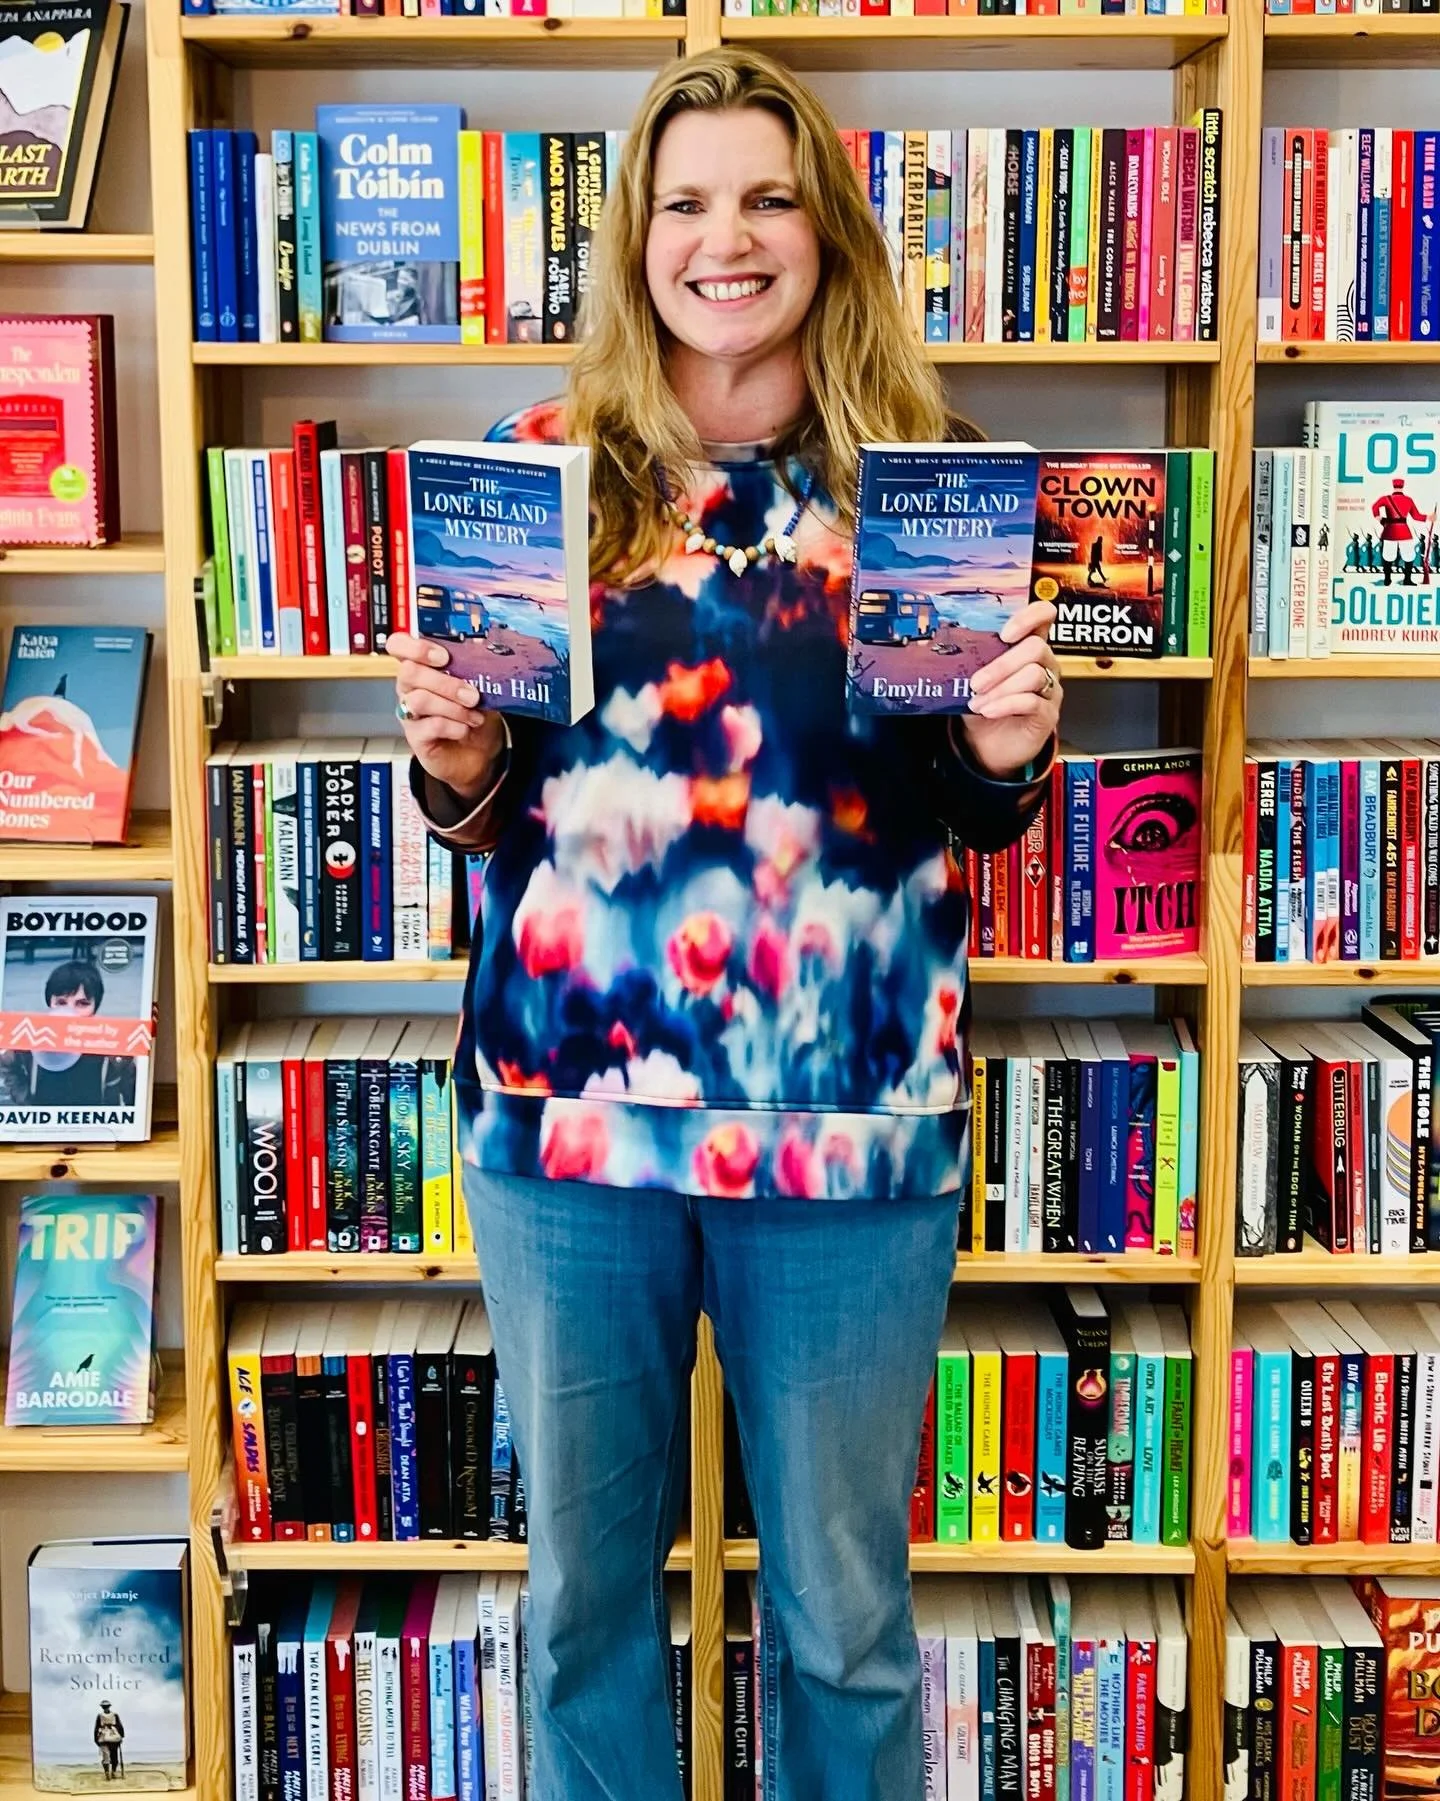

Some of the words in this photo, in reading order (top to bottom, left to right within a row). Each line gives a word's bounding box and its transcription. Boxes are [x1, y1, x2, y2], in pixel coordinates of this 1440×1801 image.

[23, 8, 93, 22] ANAPPARA
[1206, 112, 1219, 144] little
[0, 144, 53, 164] LAST
[339, 133, 433, 166] Colm
[576, 146, 588, 160] IN
[588, 141, 600, 150] A
[1361, 133, 1371, 157] ELEY
[1424, 136, 1436, 171] THINK
[549, 138, 564, 187] AMOR
[1203, 146, 1217, 204] scratch
[333, 167, 444, 200] Tóibín
[576, 164, 589, 228] MOSCOW
[1127, 154, 1139, 218] HOMECOMING
[1360, 158, 1370, 204] WILLIAMS
[1423, 175, 1434, 209] AGAIN
[377, 208, 399, 218] THE
[907, 139, 924, 261] AFTERPARTIES
[336, 221, 386, 237] NEWS
[392, 221, 441, 237] FROM
[550, 188, 565, 252] TOWLES
[356, 240, 420, 256] DUBLIN
[1202, 206, 1215, 267] rebecca
[548, 257, 560, 283] FOR
[576, 241, 589, 294] TOWLES
[1420, 233, 1432, 282] Jacqueline
[548, 285, 560, 315] TWO
[558, 267, 570, 304] TABLE
[1200, 269, 1213, 325] watson
[1421, 285, 1431, 317] Wilson
[932, 296, 943, 321] VIDA
[1337, 432, 1437, 484] LOS
[469, 477, 500, 496] THE
[935, 473, 969, 489] THE
[1039, 475, 1155, 498] CLOWN
[423, 491, 476, 517] LONE
[480, 496, 548, 526] ISLAND
[879, 493, 938, 514] LONE
[943, 493, 1019, 513] ISLAND
[1051, 497, 1146, 519] TOWN
[444, 518, 530, 546] MYSTERY
[900, 518, 997, 539] MYSTERY
[371, 525, 384, 577] POIROT
[1294, 559, 1306, 597] SILVER
[1318, 560, 1329, 595] STOLEN
[1057, 603, 1131, 625] MICK
[1293, 600, 1305, 629] BONE
[1317, 598, 1328, 629] HEART
[20, 633, 59, 652] Katya
[1341, 629, 1396, 643] ANDREY
[18, 646, 56, 660] Balen
[510, 677, 551, 704] Hall
[872, 678, 943, 703] Emylia
[0, 770, 36, 790] Our
[232, 770, 245, 793] IAN
[1123, 763, 1161, 773] GEMMA
[1164, 759, 1191, 770] AMOR
[341, 764, 355, 822] LADY
[1073, 778, 1090, 807] THE
[1260, 770, 1274, 817] VERGE
[1365, 770, 1377, 795] RAY
[0, 789, 96, 810] Numbered
[326, 764, 340, 837] JOKER
[1386, 789, 1398, 840] FAHRENHEIT
[233, 795, 247, 846] RANKIN
[1365, 795, 1377, 864] BRADBURY
[279, 820, 295, 881] KALMANN
[1073, 813, 1089, 872] FUTURE
[1386, 841, 1397, 868] 451
[236, 849, 247, 891] MIDNIGHT
[1259, 849, 1273, 891] NADIA
[1386, 871, 1396, 888] RAY
[236, 893, 247, 914] AND
[1112, 882, 1196, 934] ITCH
[1258, 896, 1272, 937] ATTIA
[1386, 888, 1396, 932] BRADBURY
[6, 911, 148, 932] BOYHOOD
[236, 915, 247, 939] BLUE
[400, 913, 410, 950] TURTON
[411, 913, 421, 950] STUART
[1418, 1055, 1431, 1089] THE
[336, 1081, 349, 1115] FIFTH
[368, 1083, 381, 1137] OBELISK
[396, 1083, 411, 1137] STONE
[1047, 1095, 1063, 1127] THE
[1332, 1074, 1346, 1148] JITTERBUG
[57, 1111, 136, 1126] KEENAN
[1417, 1093, 1430, 1138] HOLE
[336, 1117, 349, 1168] SEASON
[368, 1138, 380, 1170] GATE
[396, 1140, 410, 1169] SKY
[1047, 1128, 1062, 1178] GREAT
[253, 1121, 277, 1206] WOOL
[1047, 1181, 1062, 1228] WHEN
[26, 1212, 145, 1261] TRIP
[48, 1370, 101, 1389] AMIE
[236, 1367, 253, 1393] ACE
[1145, 1362, 1154, 1389] GWEN
[1346, 1363, 1358, 1382] DAY
[15, 1390, 133, 1410] BARRODALE
[1144, 1395, 1154, 1415] ART
[1373, 1371, 1388, 1424] Electric
[1170, 1399, 1186, 1431] FAINT
[1344, 1408, 1357, 1441] WHALE
[242, 1420, 260, 1473] SPADES
[1169, 1439, 1185, 1473] HEART
[1372, 1428, 1387, 1453] Life
[400, 1453, 411, 1481] DEAN
[1071, 1435, 1086, 1496] REAPING
[1093, 1438, 1107, 1495] SUNRISE
[1143, 1446, 1154, 1473] LOVE
[401, 1481, 412, 1503] ATTA
[101, 1589, 139, 1604] Daanje
[482, 1600, 494, 1618] LIZE
[40, 1646, 171, 1666] Remembered
[482, 1625, 495, 1670] MEDDINGS
[996, 1655, 1010, 1671] THE
[70, 1674, 144, 1692] Soldier
[357, 1660, 373, 1683] THE
[1099, 1677, 1110, 1698] THE
[1136, 1672, 1146, 1701] FAKE
[1354, 1651, 1366, 1703] PULLMAN
[1367, 1658, 1377, 1695] PHILIP
[458, 1693, 471, 1723] Wish
[733, 1676, 749, 1724] HIDDEN
[996, 1676, 1018, 1750] CHANGING
[1110, 1672, 1122, 1724] NOTHING
[358, 1688, 373, 1746] COUSINS
[1099, 1699, 1110, 1744] MOVIES
[1135, 1703, 1146, 1751] SKATING
[459, 1725, 471, 1746] You
[734, 1727, 748, 1769] GIFTS
[1111, 1726, 1122, 1750] LIKE
[459, 1748, 472, 1778] Were
[1000, 1753, 1019, 1790] MAN
